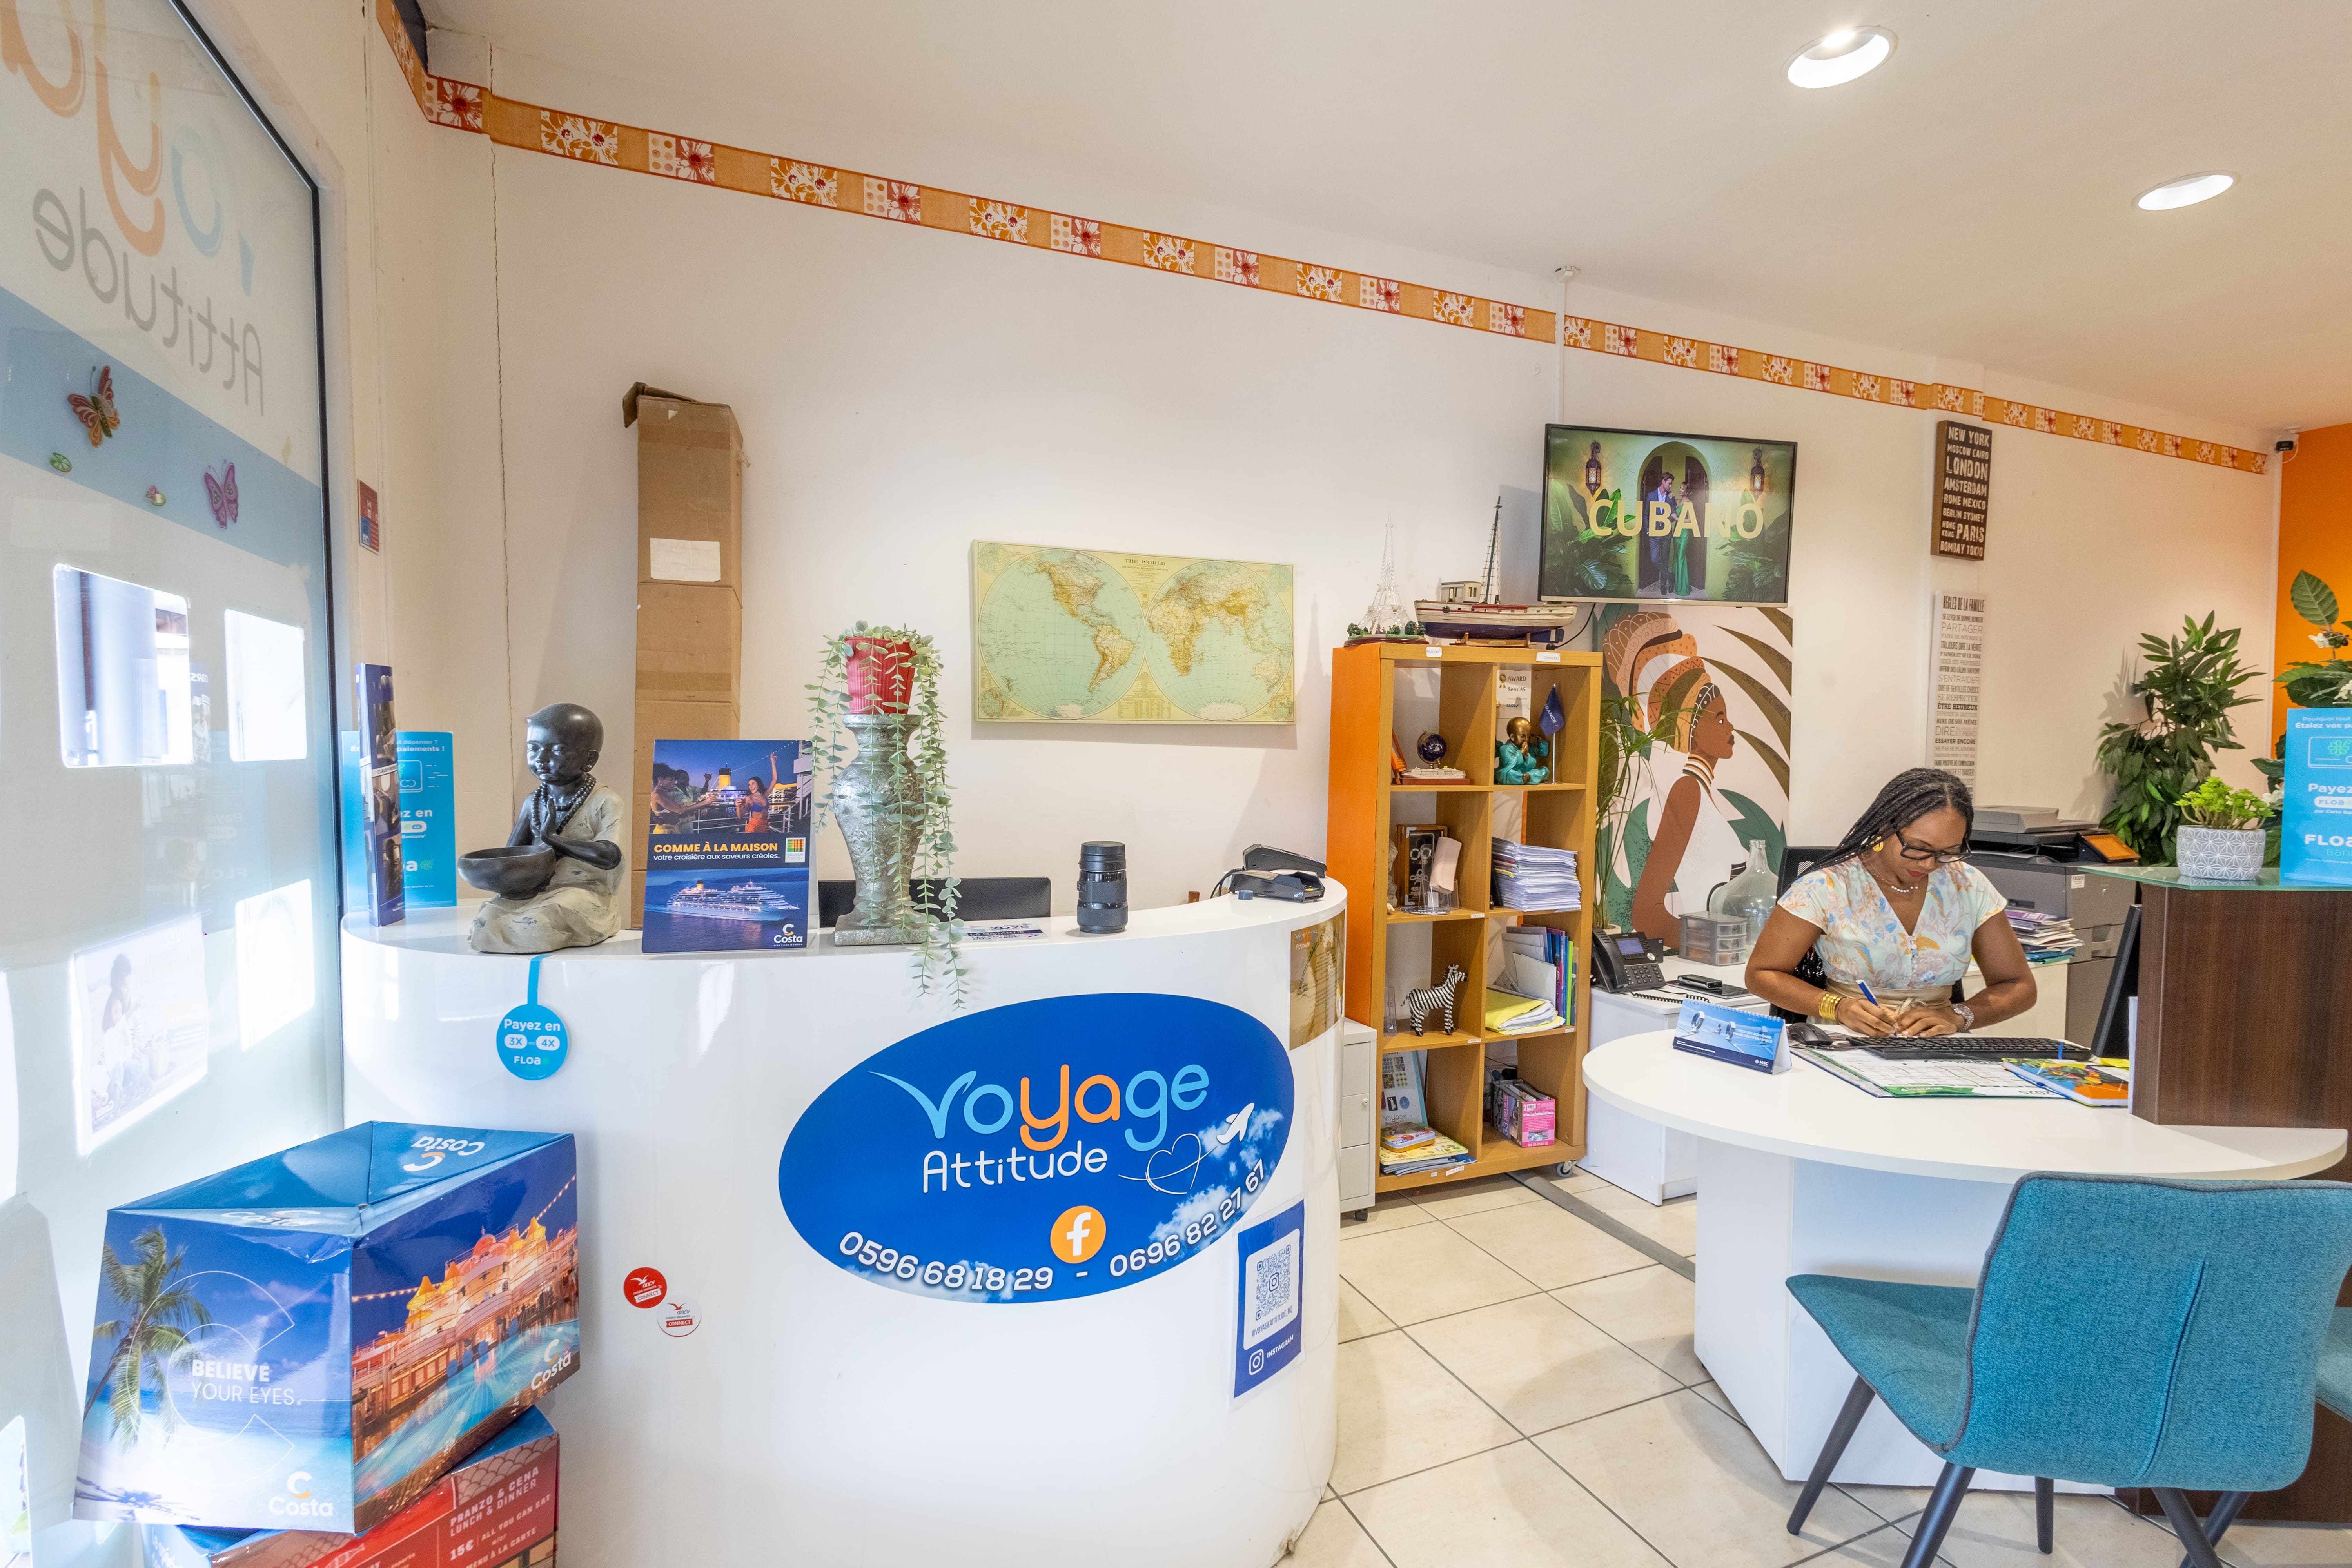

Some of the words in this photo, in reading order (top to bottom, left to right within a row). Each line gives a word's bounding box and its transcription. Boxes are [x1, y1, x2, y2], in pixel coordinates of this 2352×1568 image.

[1948, 426, 1965, 442] NEW
[1969, 431, 1990, 447] YORK
[1947, 444, 1971, 456] MOSCOW
[1973, 449, 1989, 460] CAIRO
[1946, 456, 1988, 481] LONDON
[1944, 477, 1987, 496] AMSTERDAM
[1944, 494, 1961, 505] ROME
[1963, 498, 1985, 510] MEXICO
[1589, 498, 1764, 539] CUBANO
[1943, 508, 1962, 519] BERLIN
[1963, 512, 1985, 523] SYDNEY
[1942, 521, 1955, 530] HONG
[1956, 523, 1985, 543] PARIS
[1940, 541, 1965, 552] BOMBAY
[1967, 545, 1983, 557] TOKIO
[1964, 598, 1968, 611] LA
[1941, 622, 1982, 634] PARTAGER
[1941, 641, 1958, 650] TOUJOURS
[1938, 674, 1980, 684] S'ENTRAIDER
[1935, 726, 1955, 736] DIRE
[2308, 783, 2352, 794] Payez
[415, 809, 433, 817] en
[653, 844, 700, 853] COMME
[703, 841, 712, 852] À
[714, 844, 728, 852] LA
[730, 842, 778, 852] MAISON
[773, 935, 803, 944] Costa
[1296, 941, 1310, 951] Attitude
[504, 1018, 541, 1032] Payez
[544, 1023, 561, 1031] en
[509, 1037, 522, 1045] 3X
[541, 1039, 555, 1047] 4X
[867, 1064, 1209, 1152] Voyage
[411, 1136, 485, 1156] Costa
[922, 1141, 1108, 1194] Attitude
[839, 1230, 920, 1279] 0596
[923, 1261, 965, 1288] 68
[971, 1266, 1005, 1291] 18
[1013, 1266, 1053, 1291] 29
[1110, 1234, 1181, 1277] 0696
[1186, 1213, 1217, 1245] 82
[1219, 1186, 1241, 1222] 27
[1245, 1158, 1265, 1192] 67
[642, 1280, 655, 1288] ancv
[637, 1290, 659, 1301] CONNECT
[1251, 1305, 1293, 1337] @VOYAGEATTITUDE_MQ
[1267, 1334, 1294, 1359] INSTAGRAM
[192, 1359, 270, 1383] BELIEVE
[532, 1351, 572, 1392] Costa
[192, 1382, 245, 1403] YOUR
[250, 1386, 303, 1406] EYES.
[268, 1495, 334, 1518] Costa
[450, 1494, 494, 1528] PRANZO
[497, 1488, 504, 1497] &
[508, 1466, 539, 1491] CENA
[450, 1511, 483, 1537] LUNCH
[486, 1507, 493, 1516] &
[497, 1478, 537, 1509] DINNER
[450, 1539, 474, 1561] 15€
[481, 1530, 496, 1542] ALL
[499, 1518, 514, 1531] YOU
[516, 1507, 533, 1521] CAN
[535, 1494, 552, 1509] EAT
[491, 1550, 496, 1559] À
[498, 1544, 508, 1555] LA
[510, 1526, 536, 1548] CARTE
